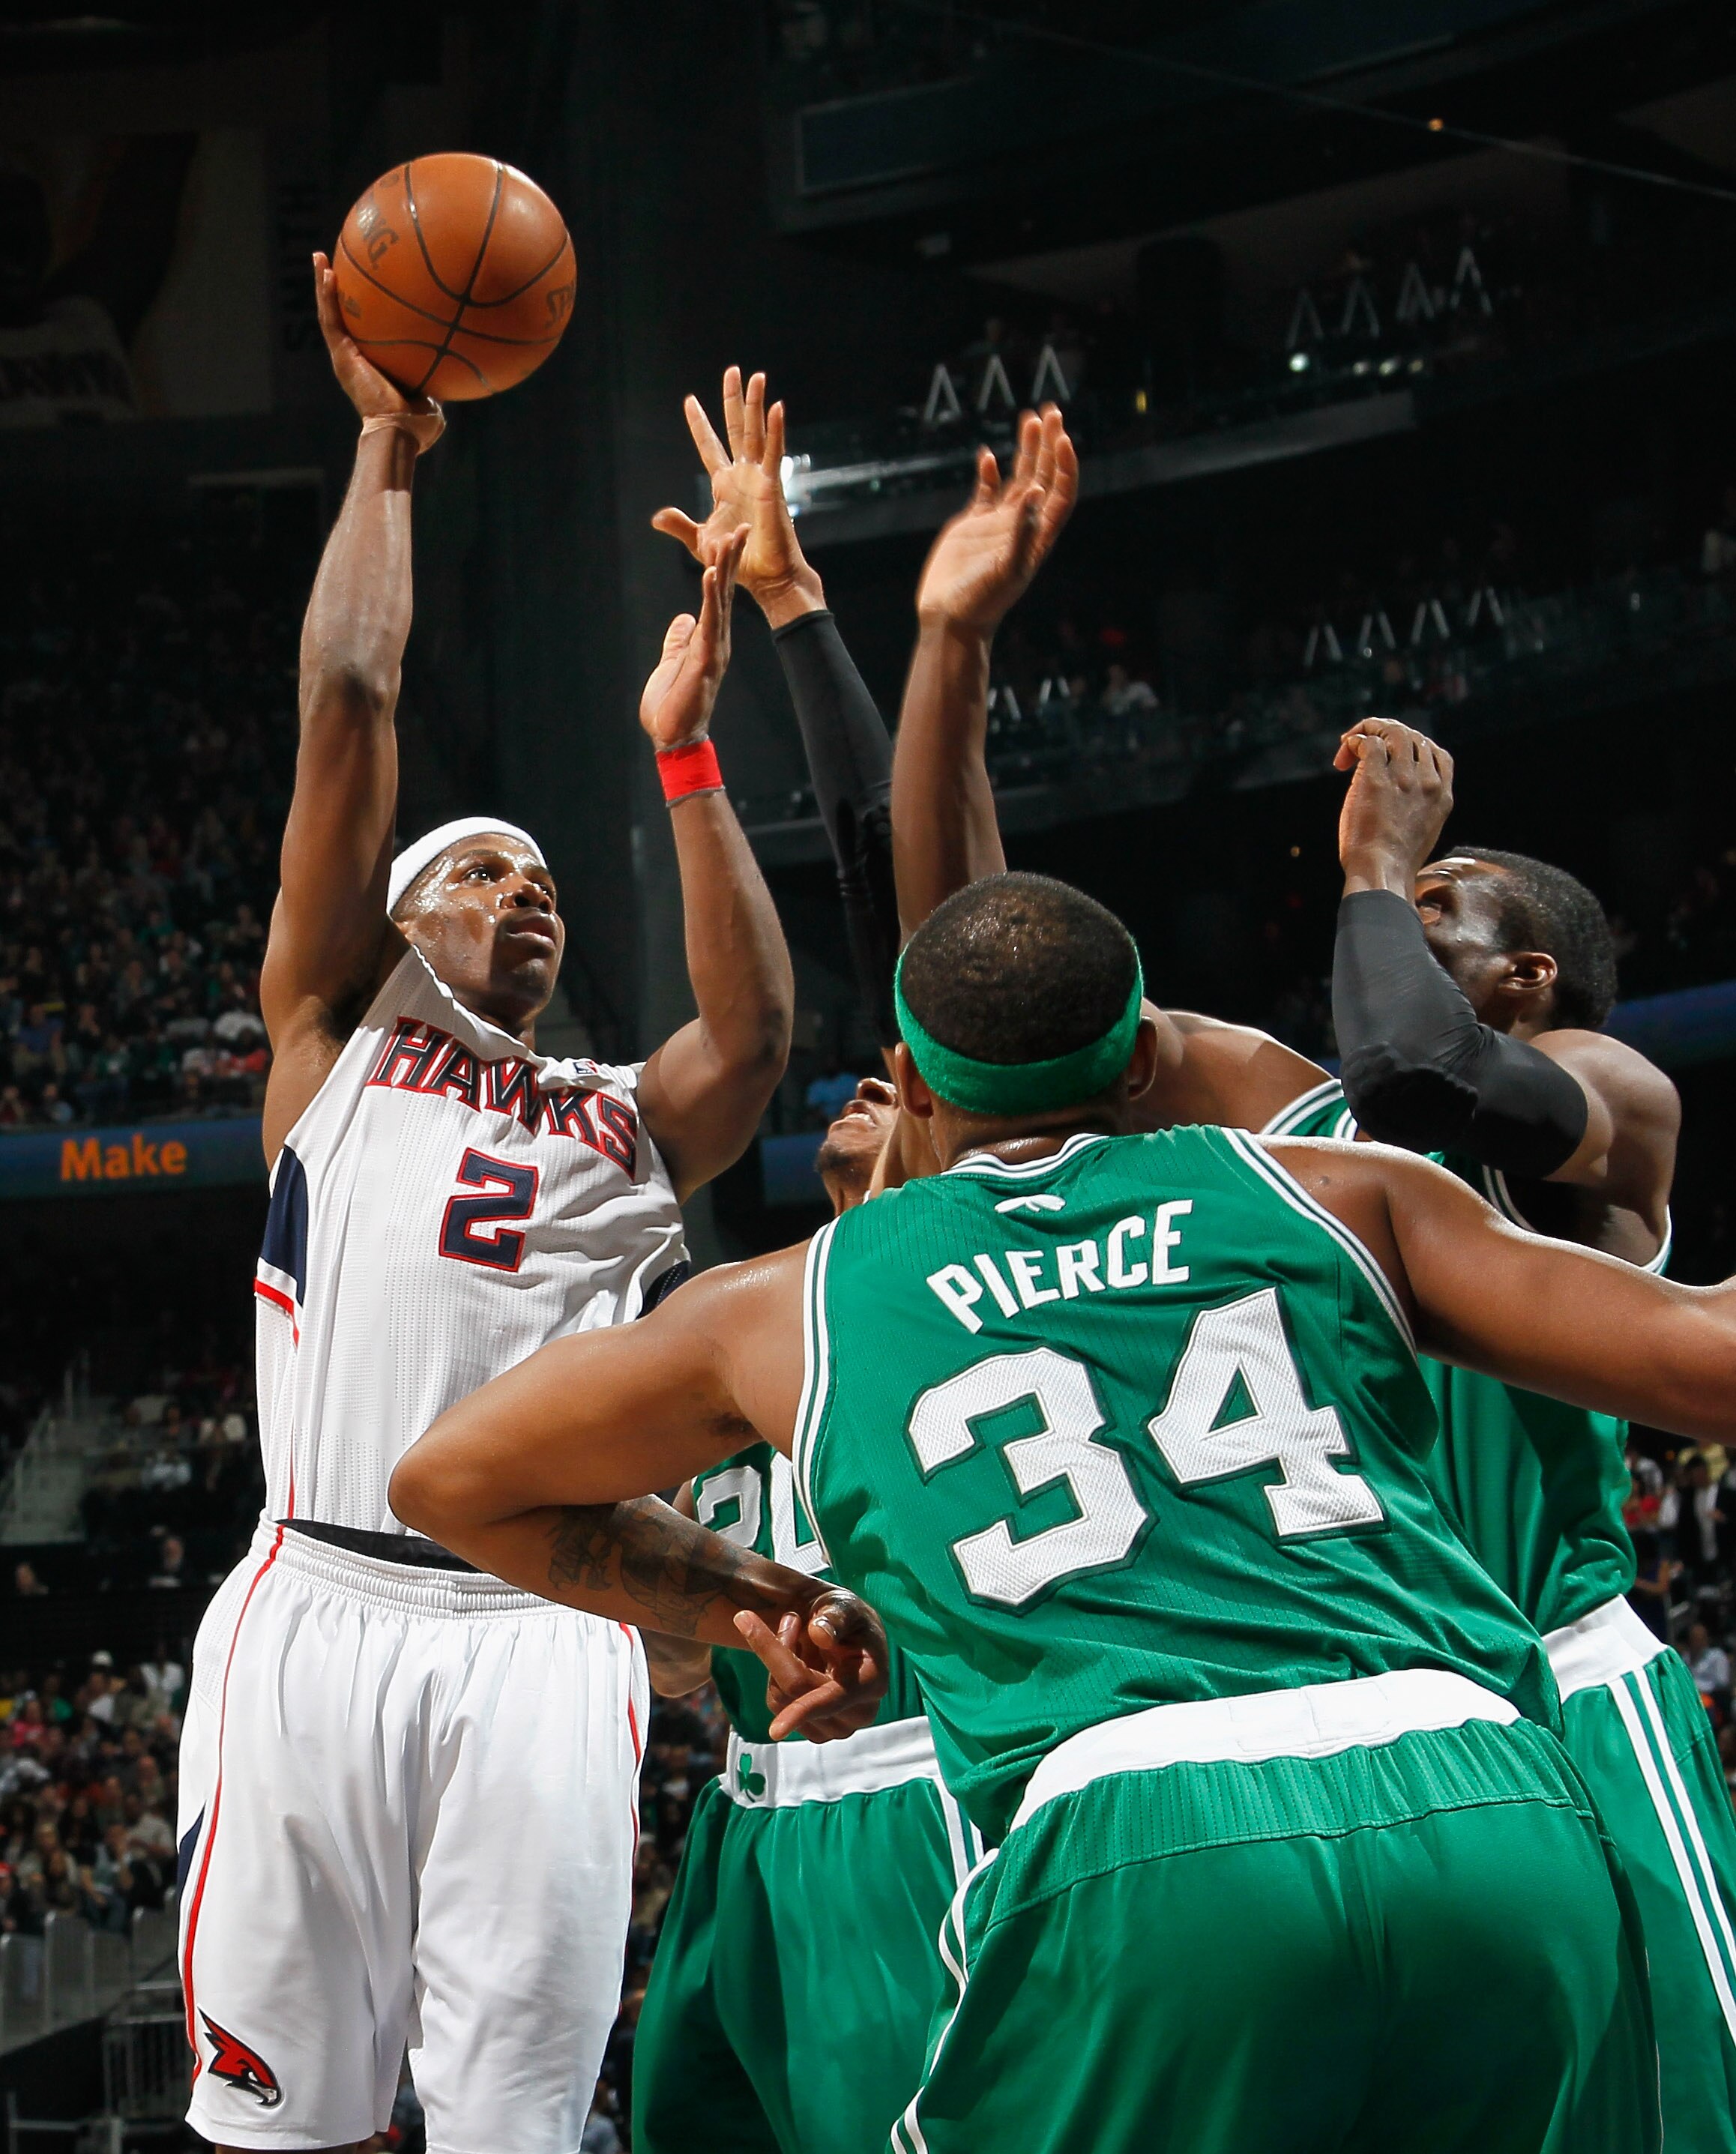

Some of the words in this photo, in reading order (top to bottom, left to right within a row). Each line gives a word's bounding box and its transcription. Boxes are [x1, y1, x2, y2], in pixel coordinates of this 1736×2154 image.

[59, 1132, 188, 1182] Make
[366, 1016, 638, 1183] HAWKS
[438, 1147, 539, 1273] 2
[926, 1198, 1193, 1335] PIERCE
[907, 1287, 1387, 1607] 34
